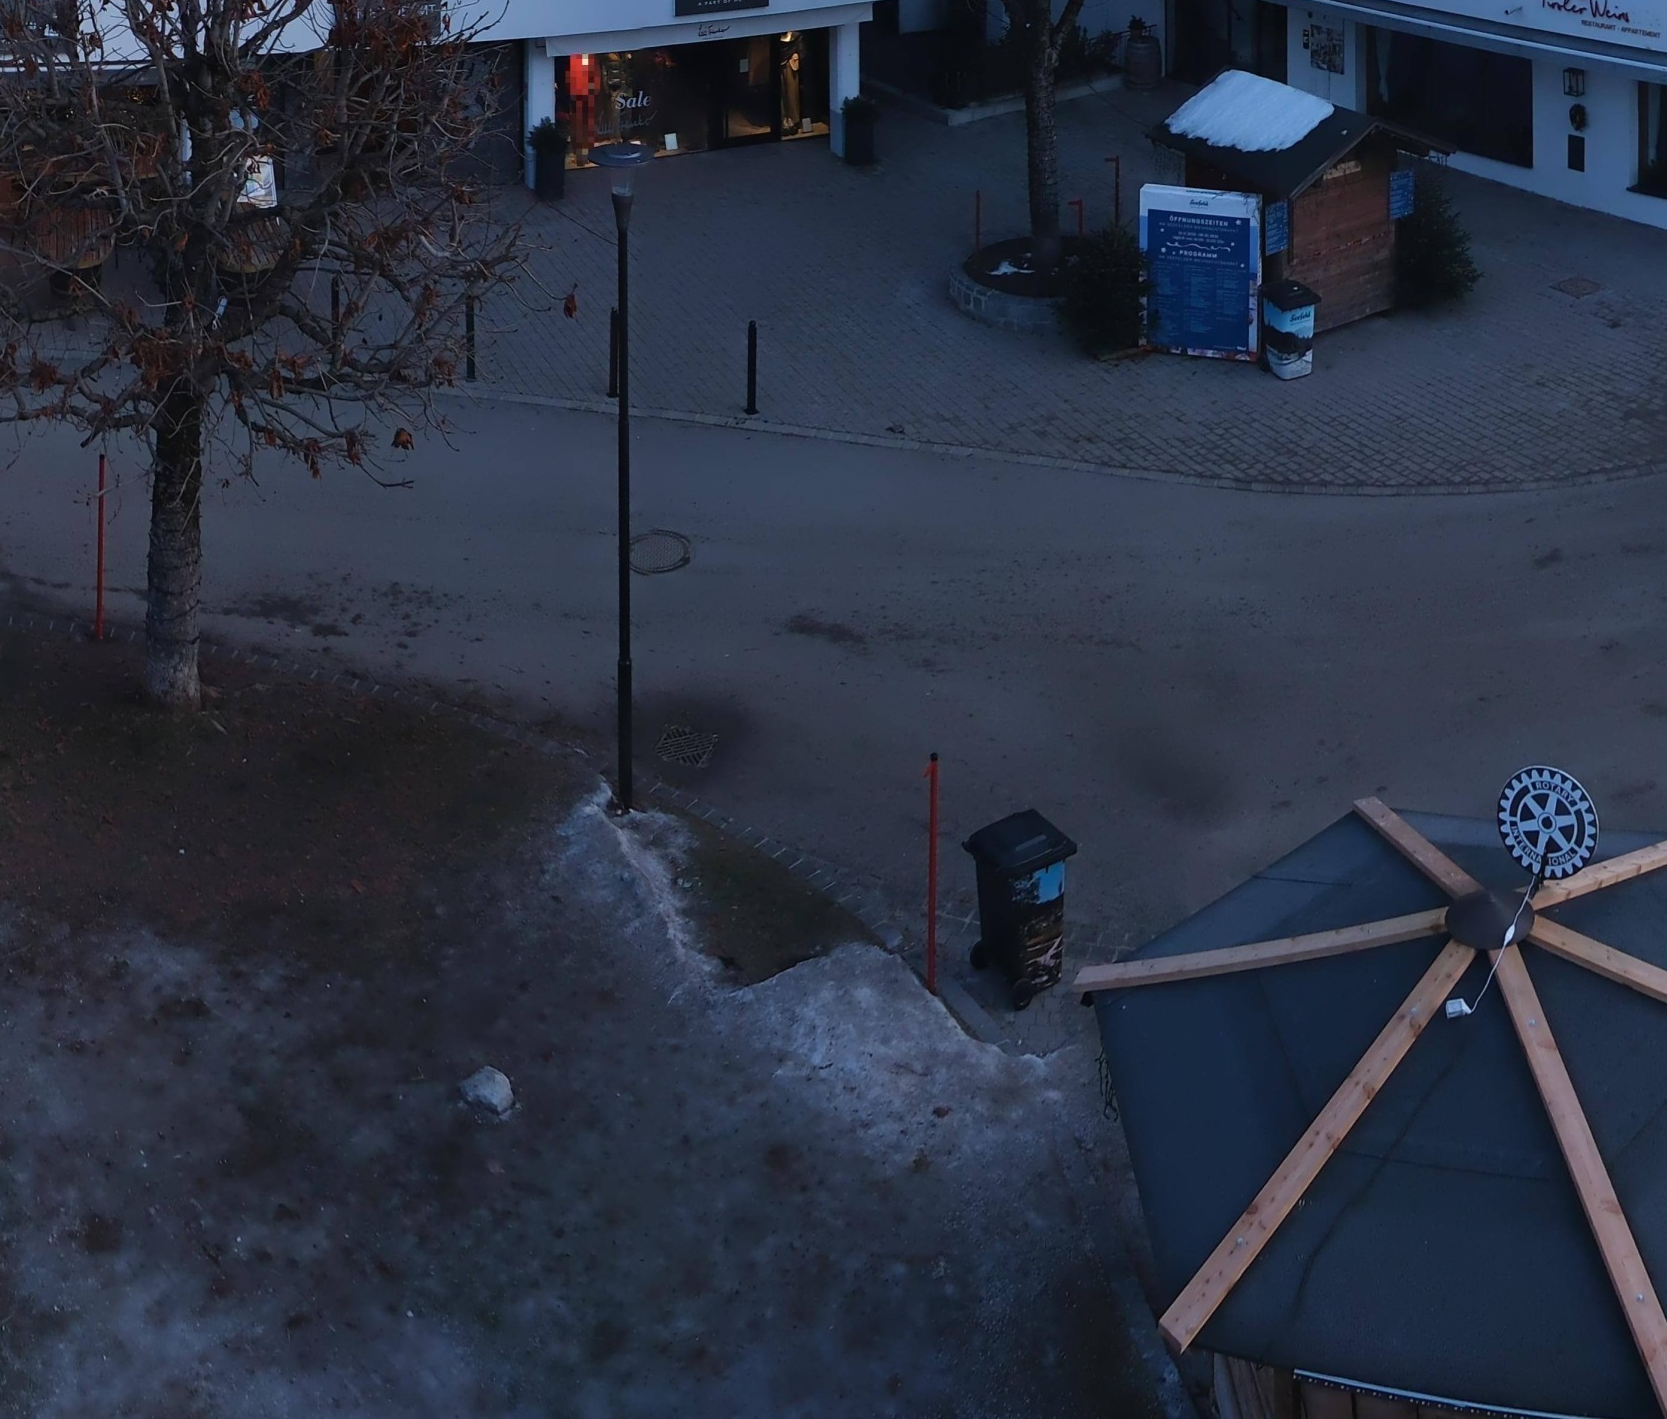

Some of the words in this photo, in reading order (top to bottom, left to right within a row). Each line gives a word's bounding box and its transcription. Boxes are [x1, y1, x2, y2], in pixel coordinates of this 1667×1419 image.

[614, 91, 652, 110] Sale
[1169, 215, 1229, 227] ÖFFNUNGSZEITEN
[1178, 249, 1218, 259] PROGRAMM
[1535, 781, 1575, 803] ROTARY
[1510, 825, 1577, 867] INTERNAIONAL
